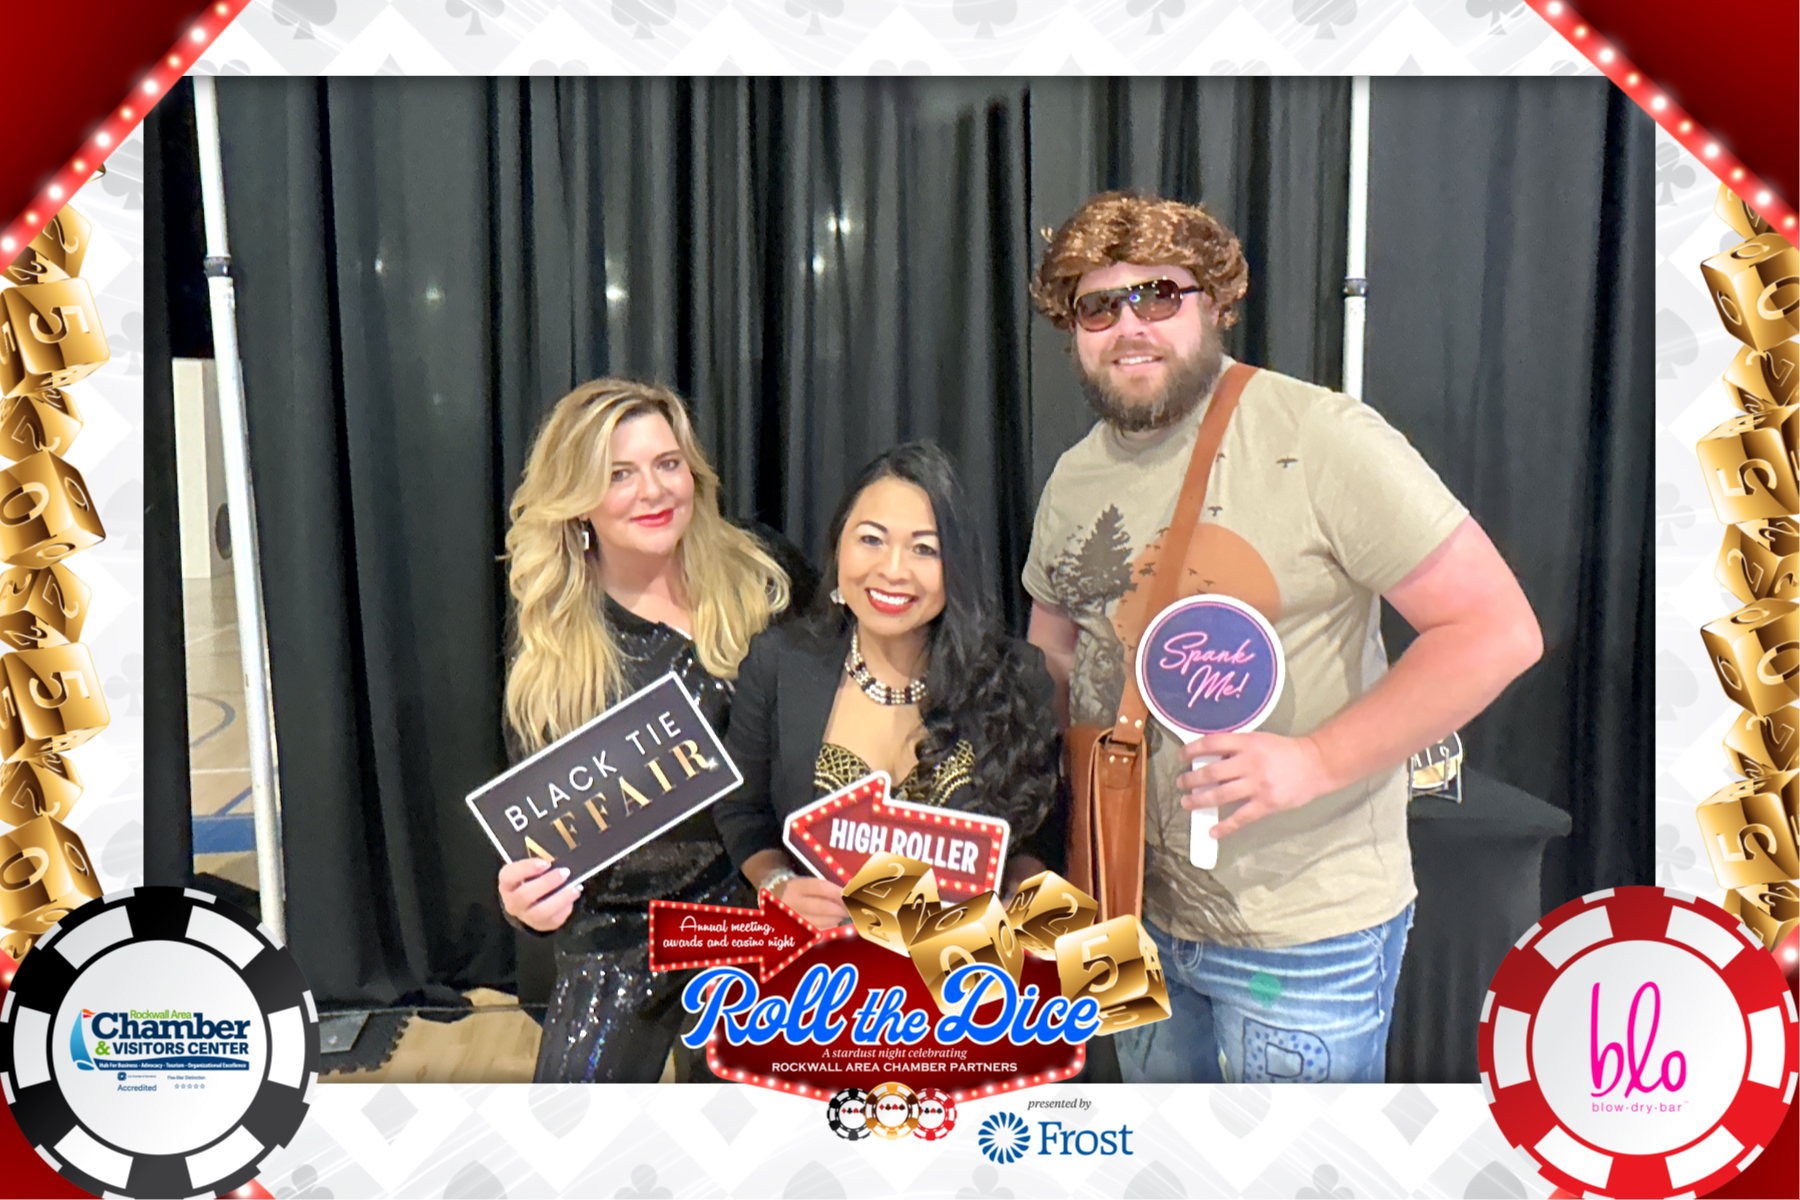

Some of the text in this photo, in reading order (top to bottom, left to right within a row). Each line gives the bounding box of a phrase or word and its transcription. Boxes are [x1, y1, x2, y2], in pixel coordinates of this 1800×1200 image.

[1160, 632, 1255, 675] Spank
[1187, 665, 1249, 708] Me!
[504, 711, 681, 832] BLACK TIE
[524, 738, 711, 865] AFFAIR
[829, 818, 979, 874] HIGH ROLLER
